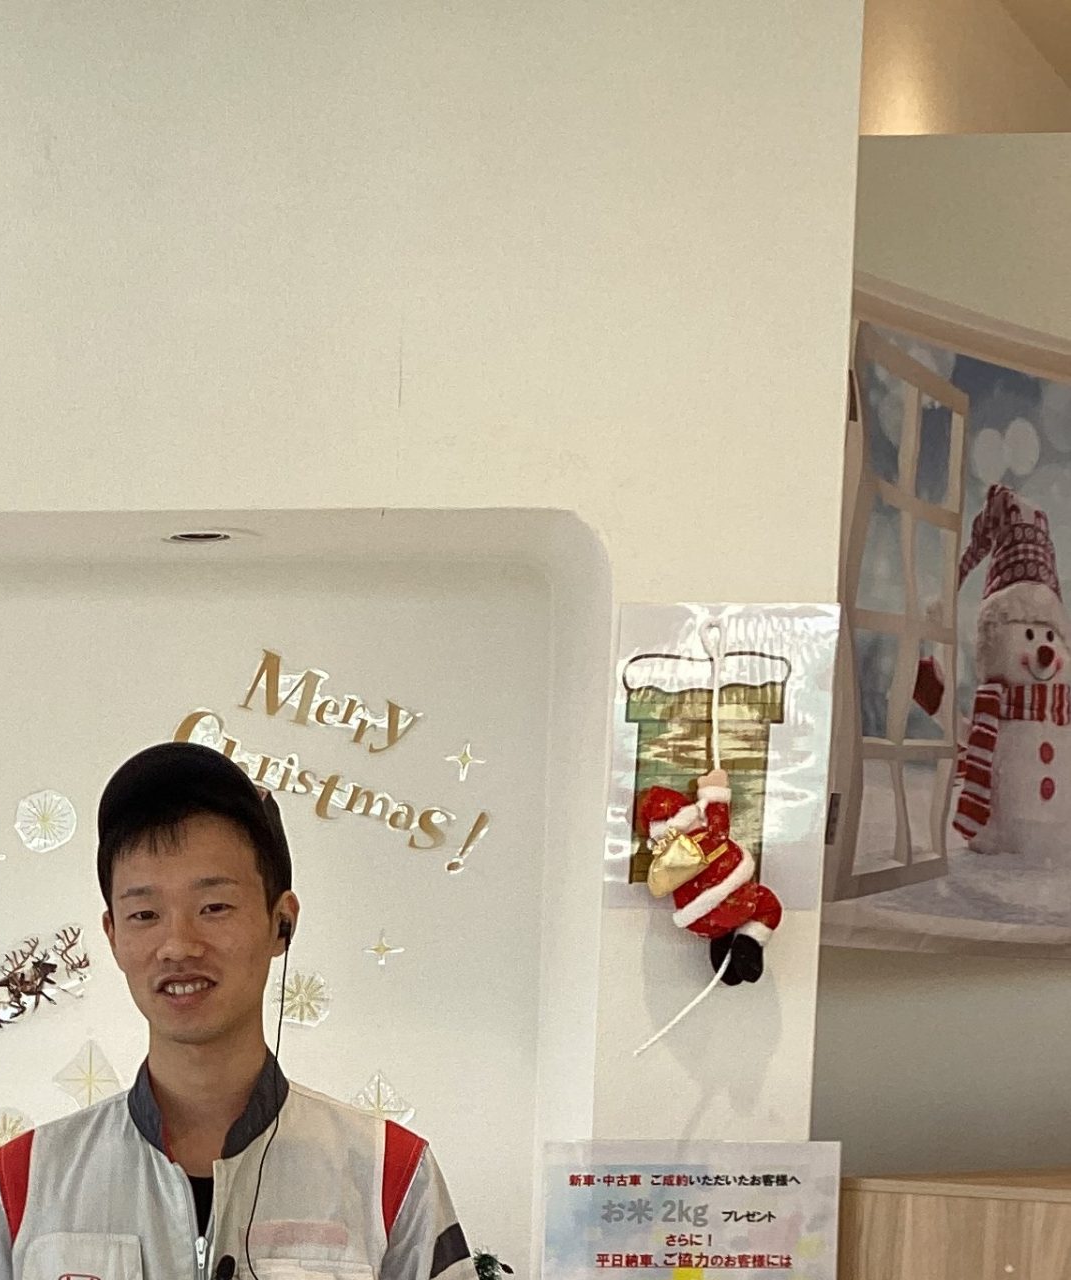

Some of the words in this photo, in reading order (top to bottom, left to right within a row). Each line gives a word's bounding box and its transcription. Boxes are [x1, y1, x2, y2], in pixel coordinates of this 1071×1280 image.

[237, 648, 419, 753] Merry
[569, 1174, 642, 1187] 新車・中古車
[721, 1210, 777, 1222] プレゼント
[595, 1252, 793, 1268] 平日納車、ご協力のお客様には
